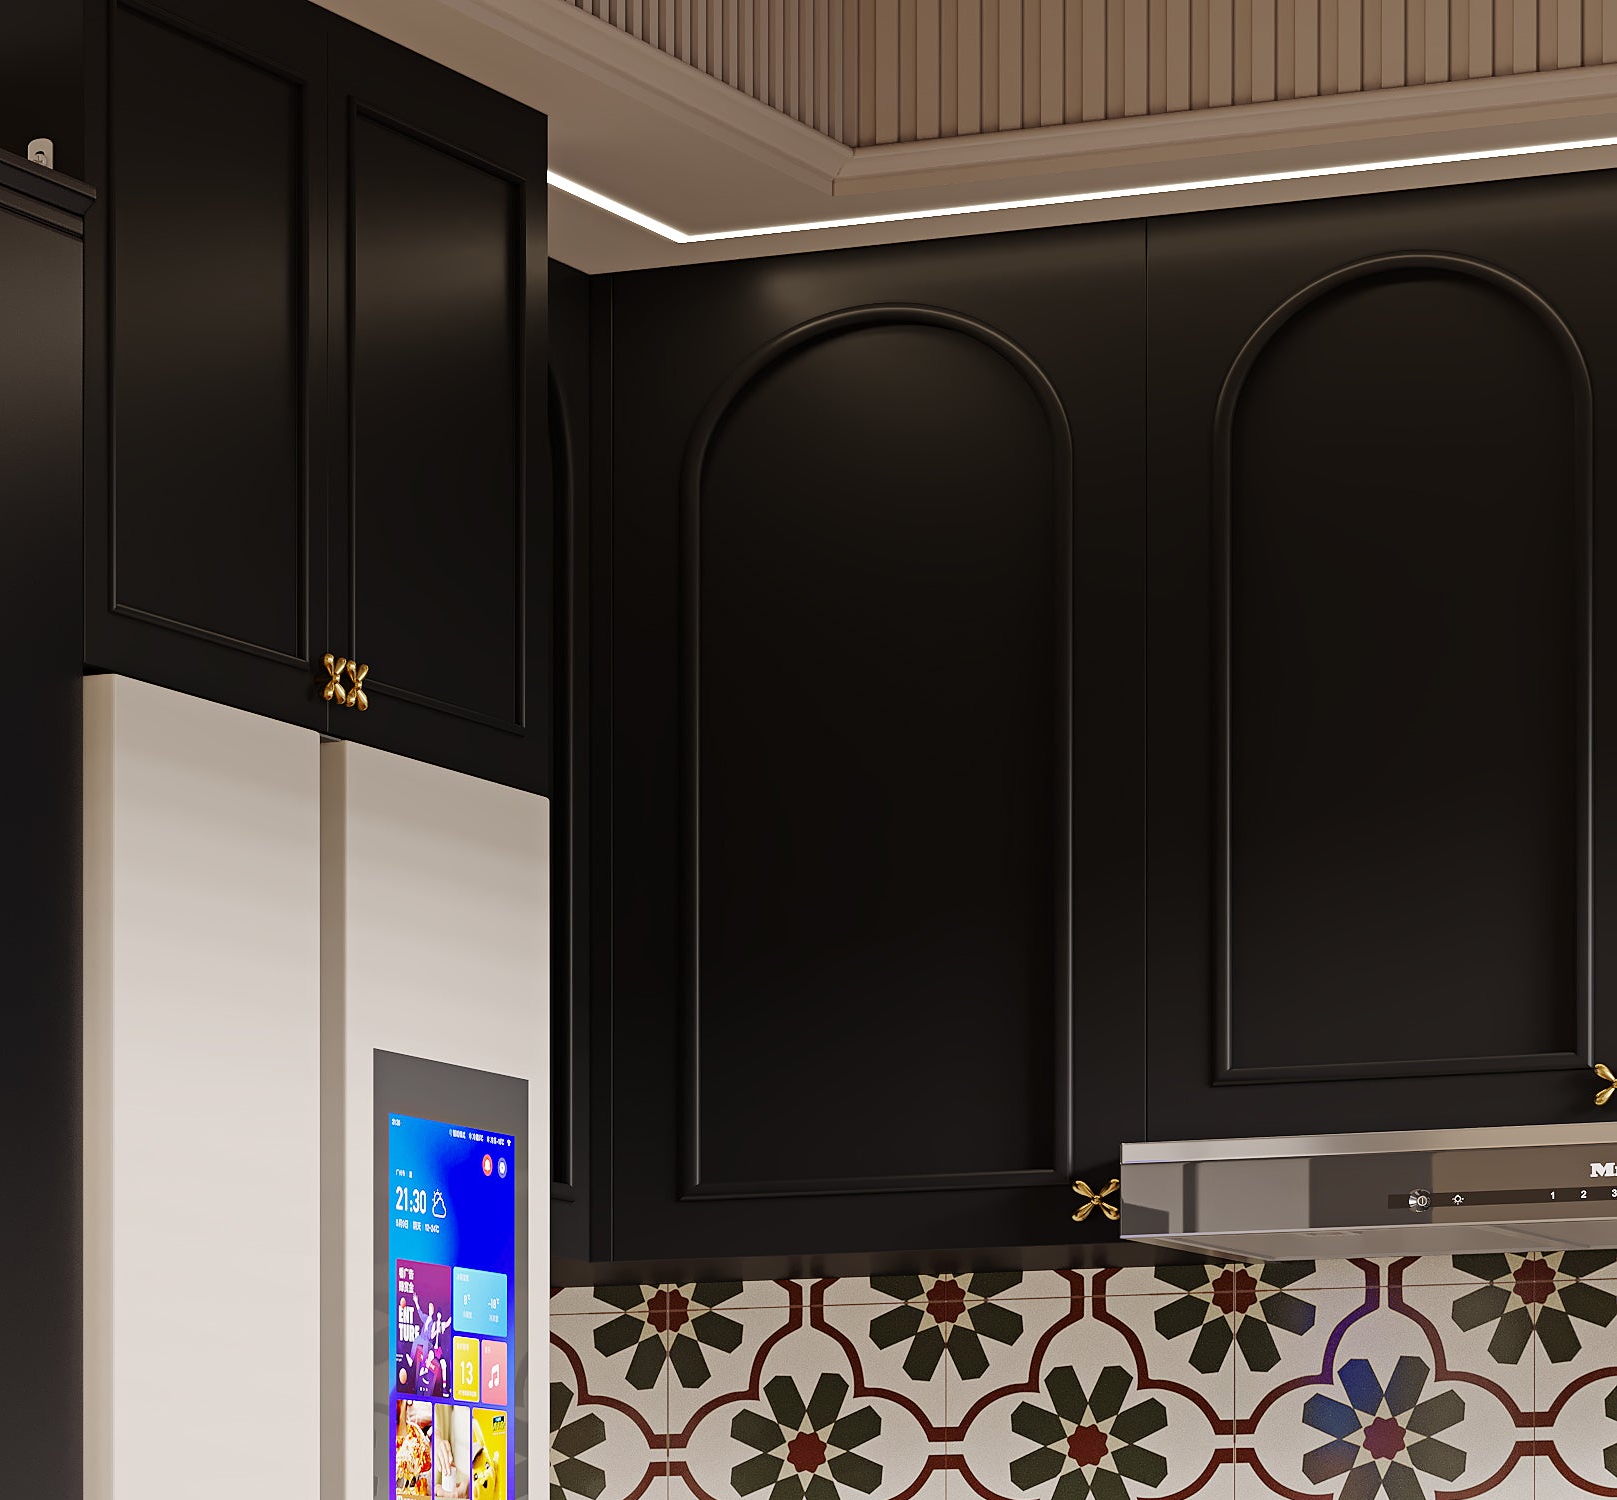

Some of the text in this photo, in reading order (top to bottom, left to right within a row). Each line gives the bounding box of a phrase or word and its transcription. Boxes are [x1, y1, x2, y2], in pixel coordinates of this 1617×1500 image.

[395, 1185, 427, 1214] 21:30
[1550, 1191, 1555, 1199] 1
[1581, 1190, 1587, 1198] 2
[460, 1361, 474, 1385] 13
